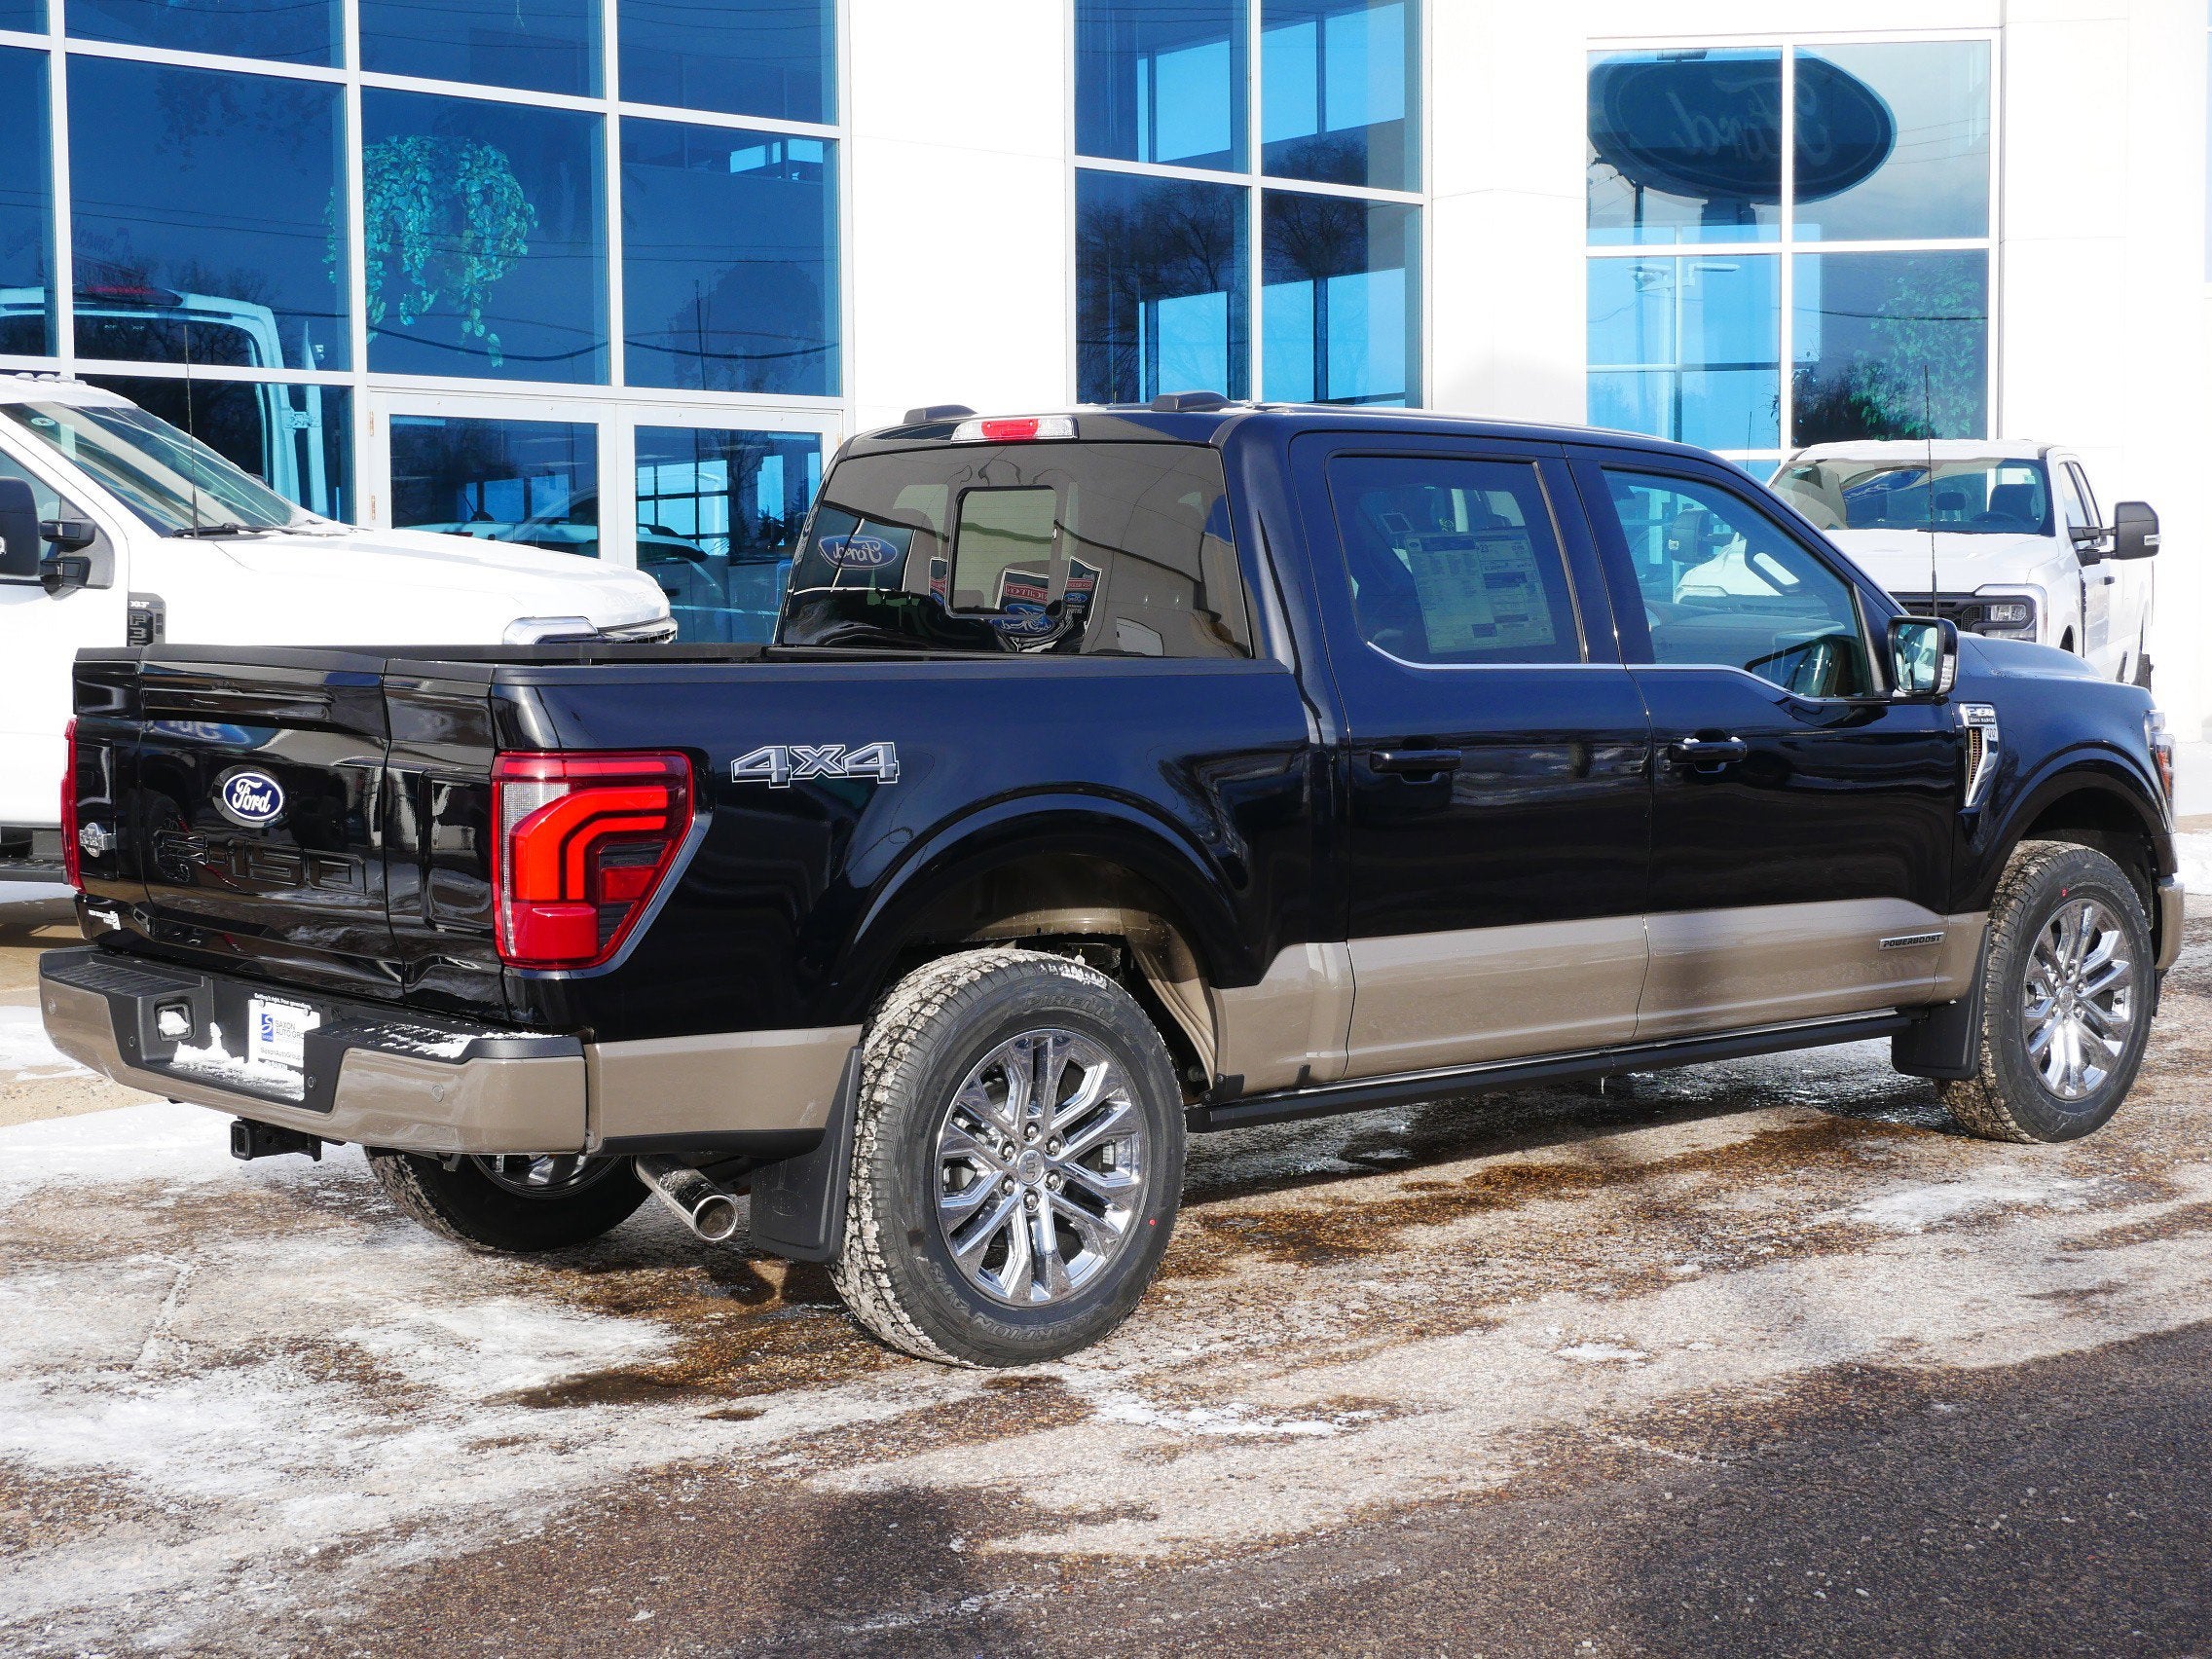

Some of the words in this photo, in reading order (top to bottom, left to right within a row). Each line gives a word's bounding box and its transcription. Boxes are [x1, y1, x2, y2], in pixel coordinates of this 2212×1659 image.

[232, 778, 273, 813] Ford
[1883, 935, 1941, 947] POWERBOOST
[275, 1019, 295, 1030] SAXON
[276, 1028, 291, 1038] AUTO
